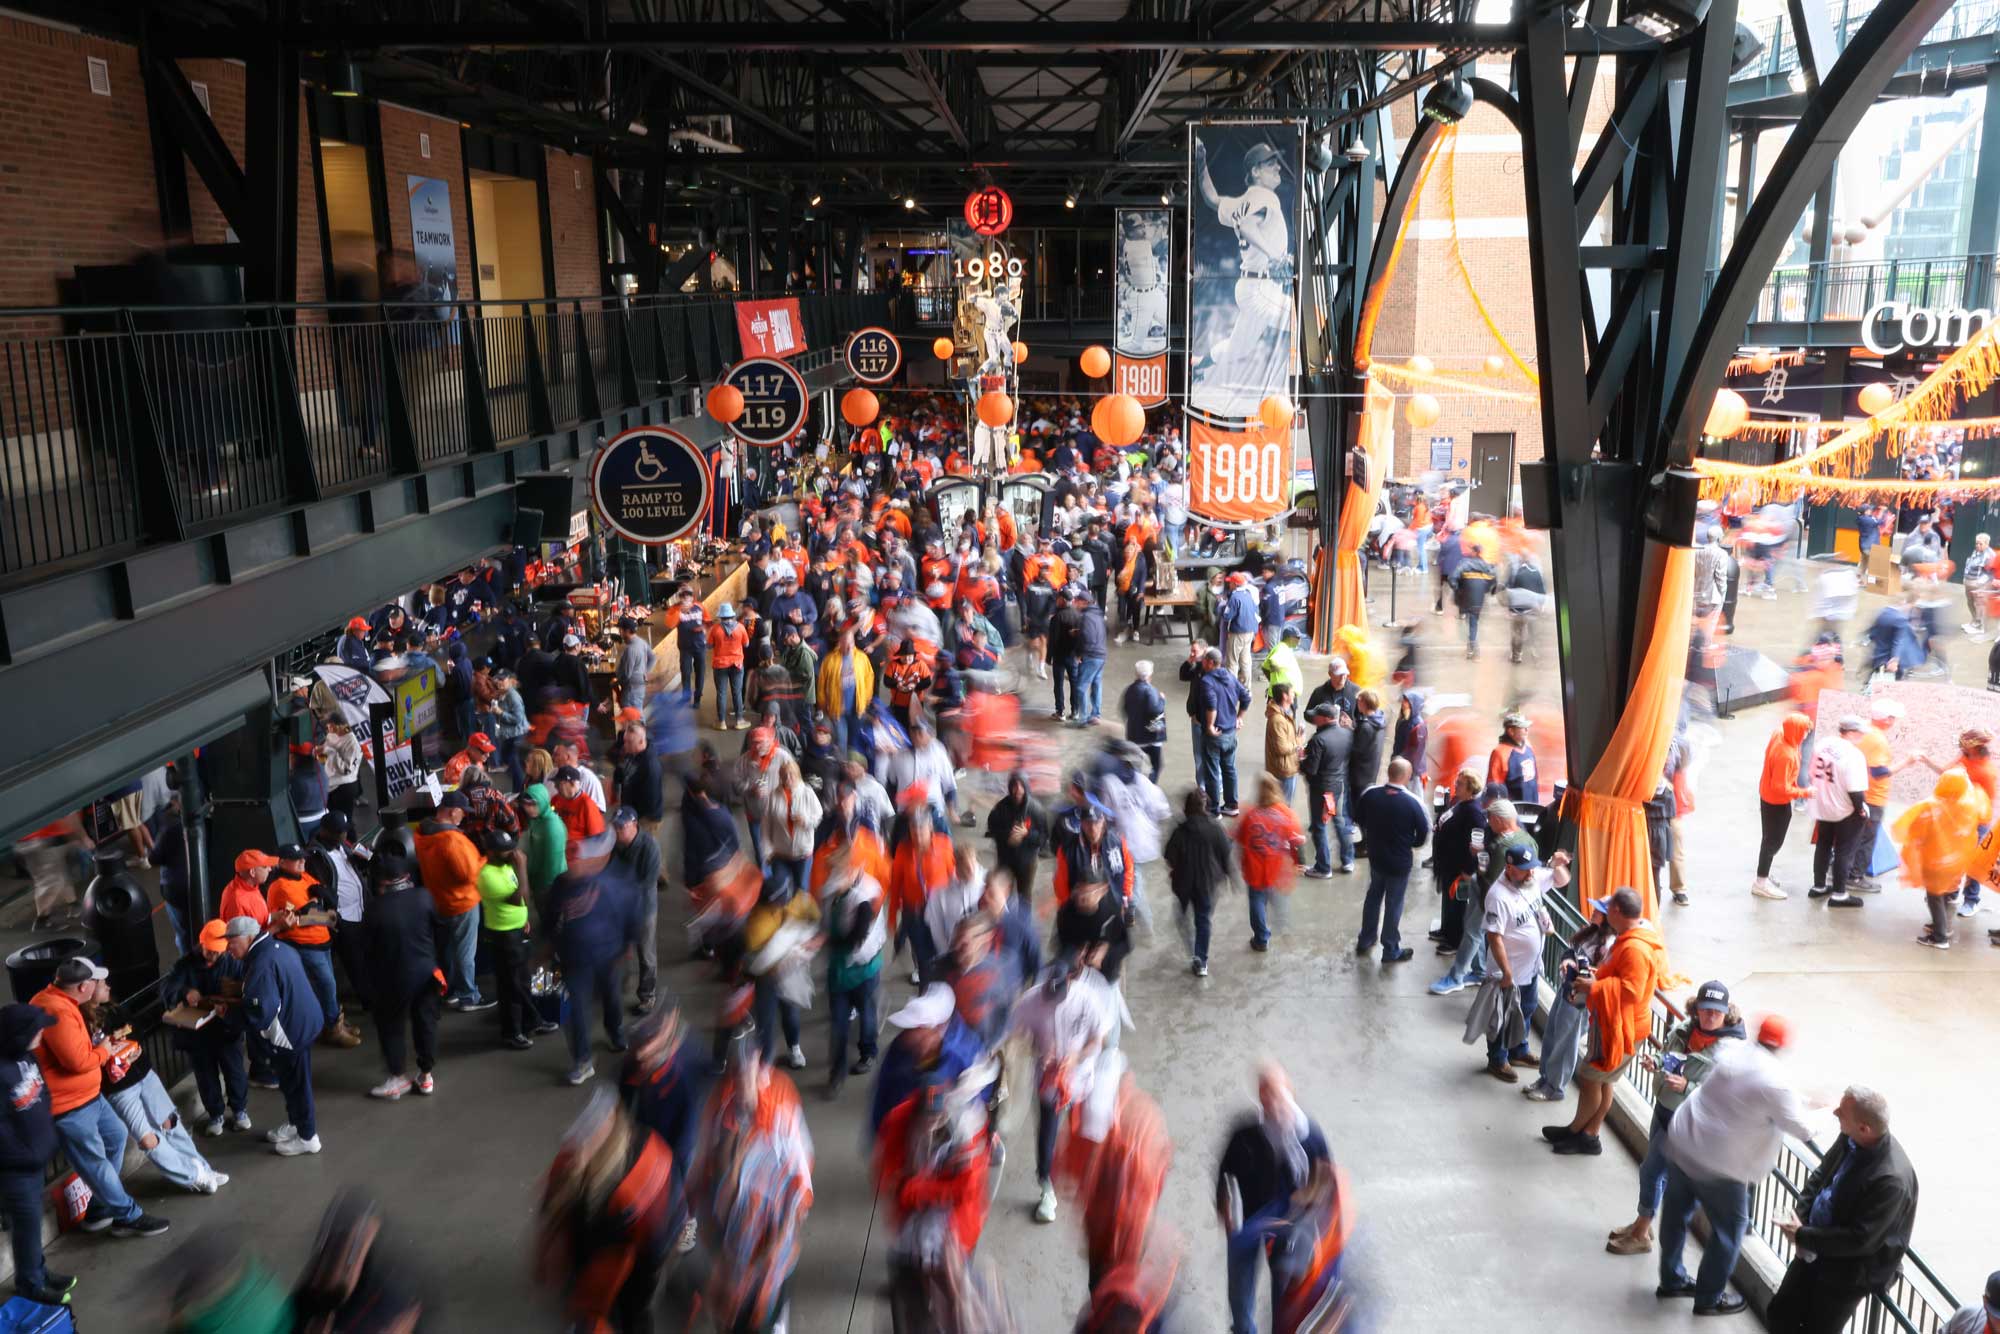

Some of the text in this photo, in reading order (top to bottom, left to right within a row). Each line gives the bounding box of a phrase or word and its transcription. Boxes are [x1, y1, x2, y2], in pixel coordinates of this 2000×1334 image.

[416, 231, 451, 246] TEAMWORK
[954, 252, 1023, 286] 1980
[860, 338, 888, 352] 116
[860, 358, 888, 372] 117
[739, 374, 785, 397] 117
[1120, 364, 1162, 397] 1980
[740, 407, 786, 429] 119
[1199, 442, 1281, 504] 1980
[622, 492, 682, 505] RAMP TO
[622, 505, 686, 519] 100 LEVEL
[387, 759, 413, 780] BUY
